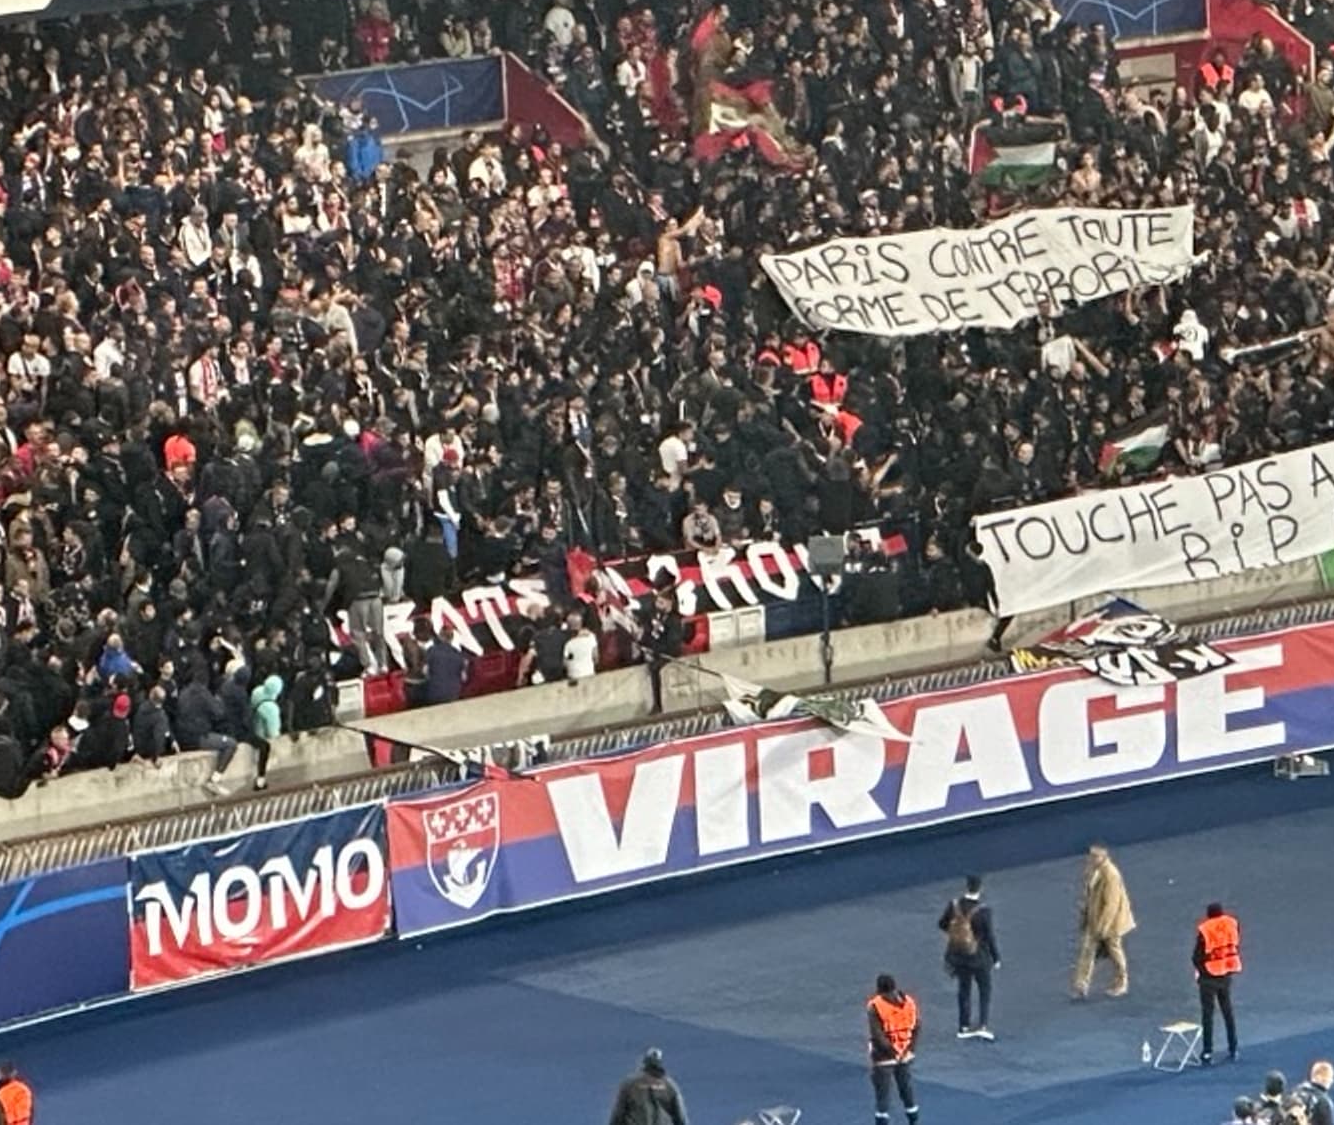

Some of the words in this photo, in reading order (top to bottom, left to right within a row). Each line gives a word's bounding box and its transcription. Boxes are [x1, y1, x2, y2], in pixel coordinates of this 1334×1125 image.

[928, 217, 1047, 279] CONTRE
[1059, 213, 1175, 249] TOUTE
[921, 288, 982, 322] DE
[982, 483, 1192, 565] TOUCHE
[1208, 460, 1292, 521] PAS
[546, 643, 1287, 884] VIRAGE
[135, 838, 386, 956] MOMO
